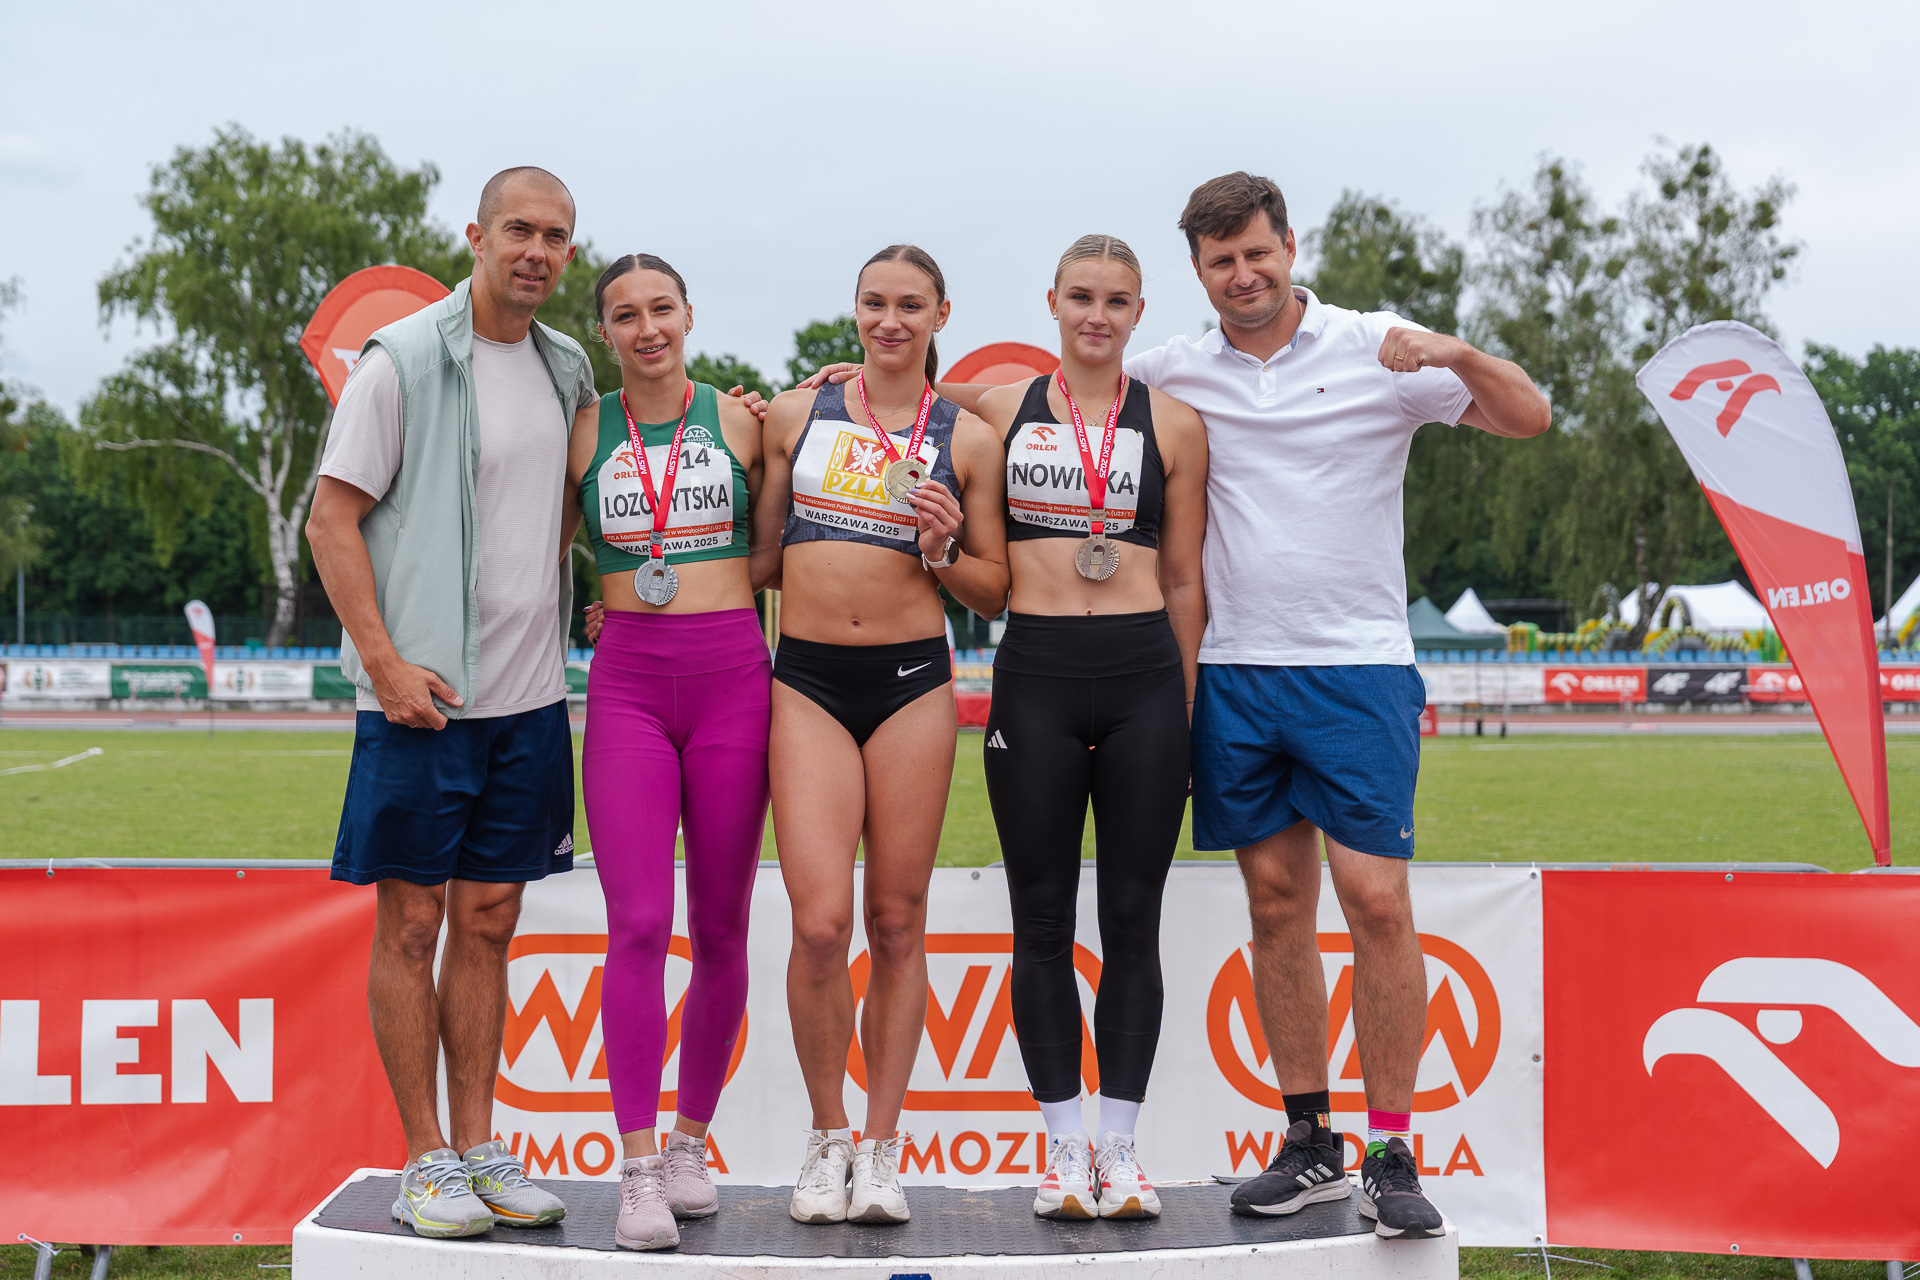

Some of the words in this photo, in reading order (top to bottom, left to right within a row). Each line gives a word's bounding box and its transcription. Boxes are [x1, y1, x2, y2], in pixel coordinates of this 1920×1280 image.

[688, 430, 706, 438] AZS
[908, 441, 919, 459] POLS
[1026, 443, 1057, 451] ORLEN
[1103, 429, 1113, 458] POLSKI
[680, 447, 711, 470] 14
[613, 470, 641, 480] ORLE
[1099, 459, 1108, 479] 2025
[826, 471, 886, 501] PZLA
[1012, 462, 1135, 495] NOWIKA
[604, 484, 730, 519] LOZOYTSKA
[836, 503, 853, 512] Polski
[859, 507, 892, 520] wielobojach
[805, 509, 869, 531] WARSZAWA
[872, 523, 900, 536] 2025
[1023, 513, 1089, 529] WARSZAWA
[620, 532, 650, 540] Mistrzostw
[622, 540, 692, 553] WARAWA
[694, 536, 719, 547] 2025
[1582, 675, 1640, 692] ORLEN
[554, 843, 574, 856] adidas
